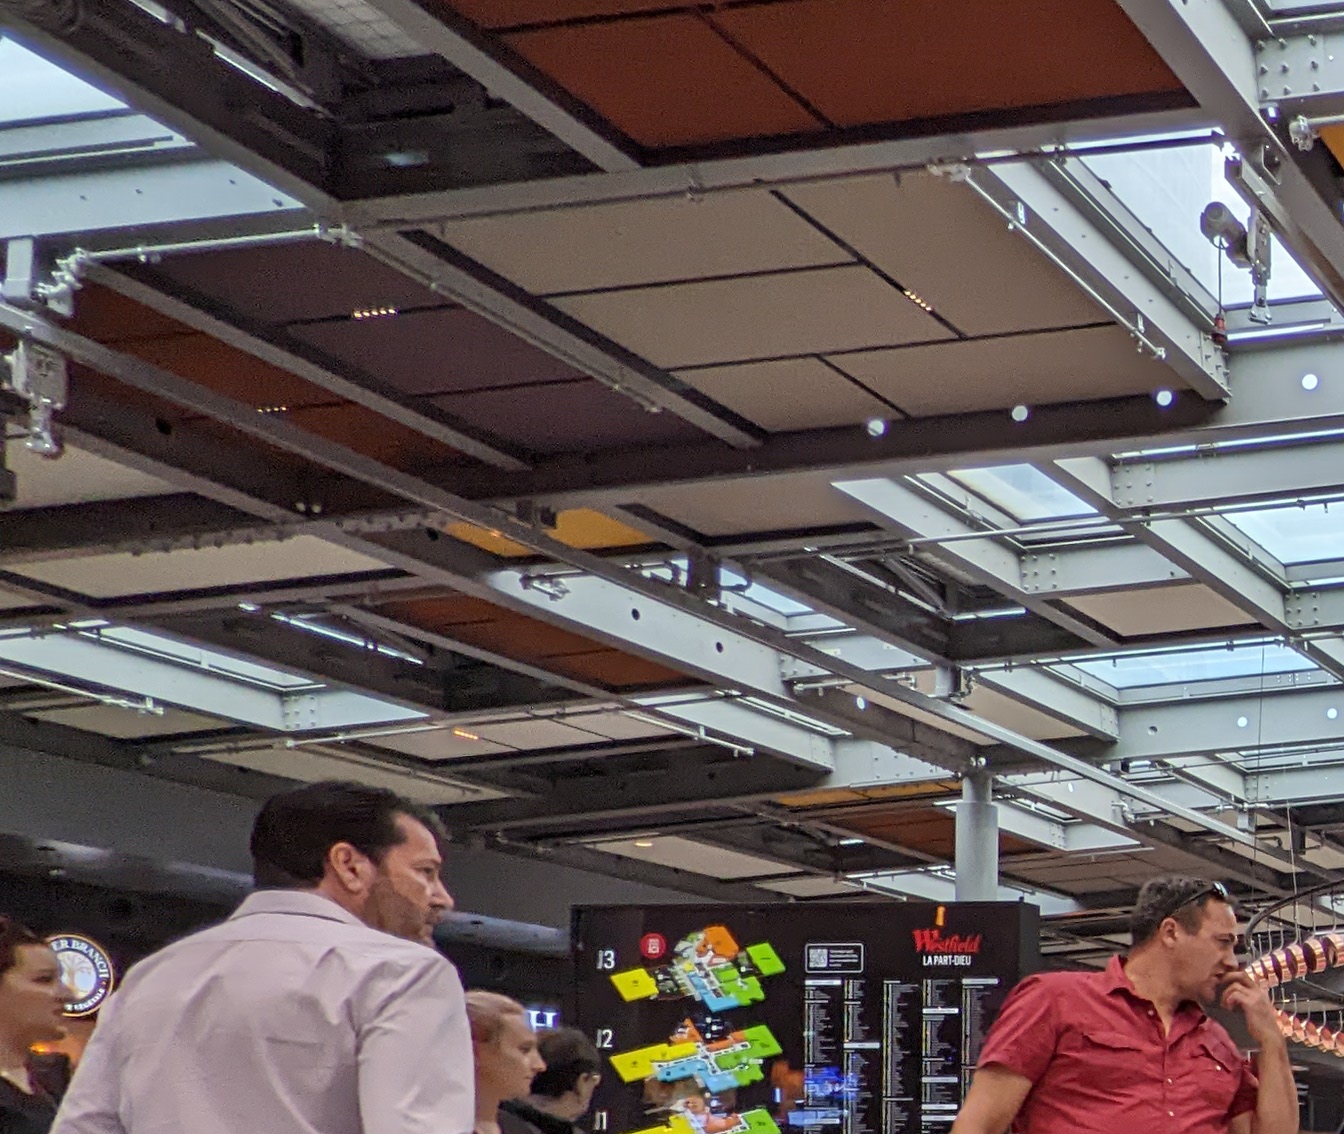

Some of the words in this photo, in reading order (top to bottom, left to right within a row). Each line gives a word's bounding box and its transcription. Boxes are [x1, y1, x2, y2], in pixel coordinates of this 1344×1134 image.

[911, 929, 981, 953] Westfield
[923, 955, 932, 966] LA
[933, 954, 971, 966] PART-DIEU
